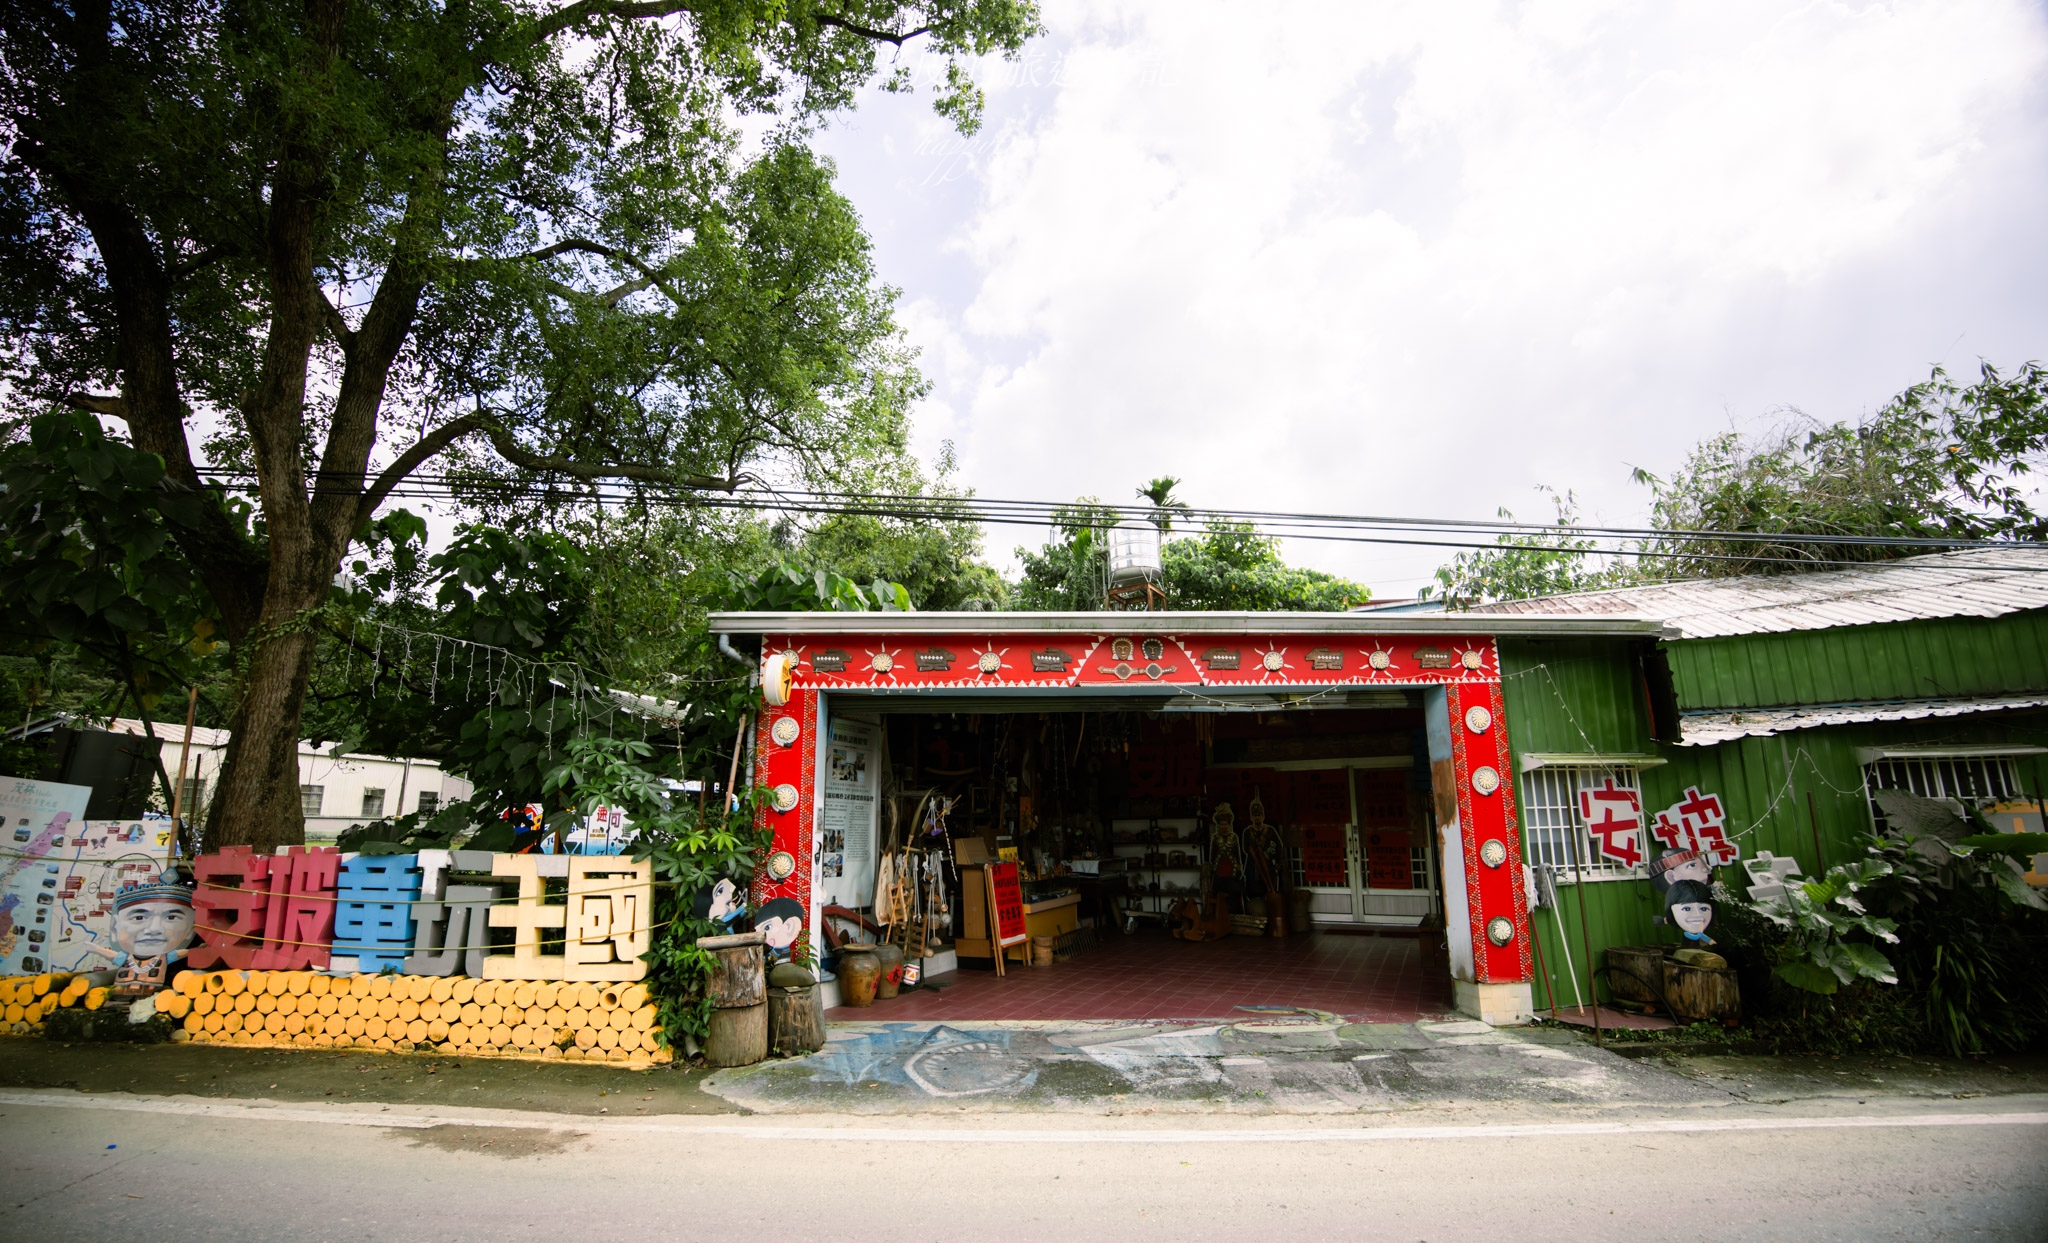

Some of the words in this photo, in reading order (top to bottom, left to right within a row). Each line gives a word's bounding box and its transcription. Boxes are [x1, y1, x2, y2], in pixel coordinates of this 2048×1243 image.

[188, 844, 654, 983] 安坡童玩王國
